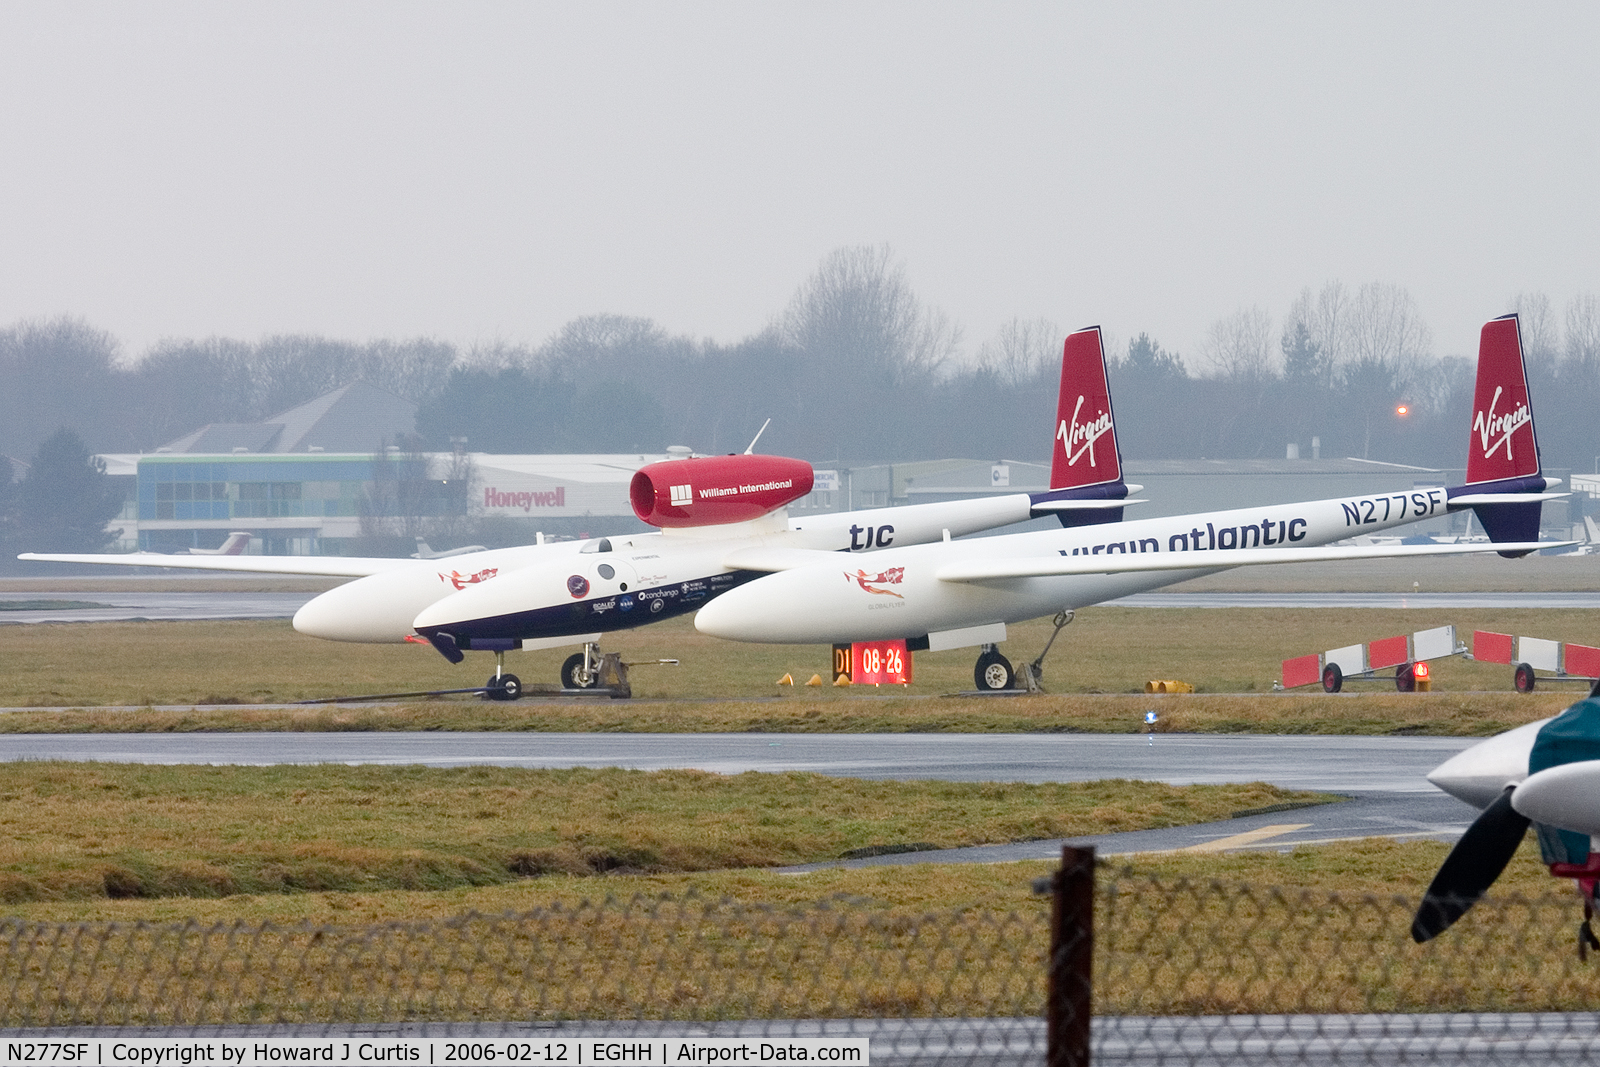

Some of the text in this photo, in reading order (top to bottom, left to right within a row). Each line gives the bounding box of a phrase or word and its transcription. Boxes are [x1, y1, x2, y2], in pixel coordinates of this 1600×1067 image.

[1056, 395, 1113, 467] Virgin
[1473, 385, 1531, 460] Virgin
[484, 486, 565, 512] Honeywell
[699, 479, 792, 498] Williams International
[1341, 490, 1441, 526] N277SF
[1168, 518, 1307, 551] atlantic
[645, 589, 679, 599] conchango
[868, 601, 905, 611] GLOBALFLYER
[836, 649, 850, 673] D1
[863, 648, 902, 674] 08-26
